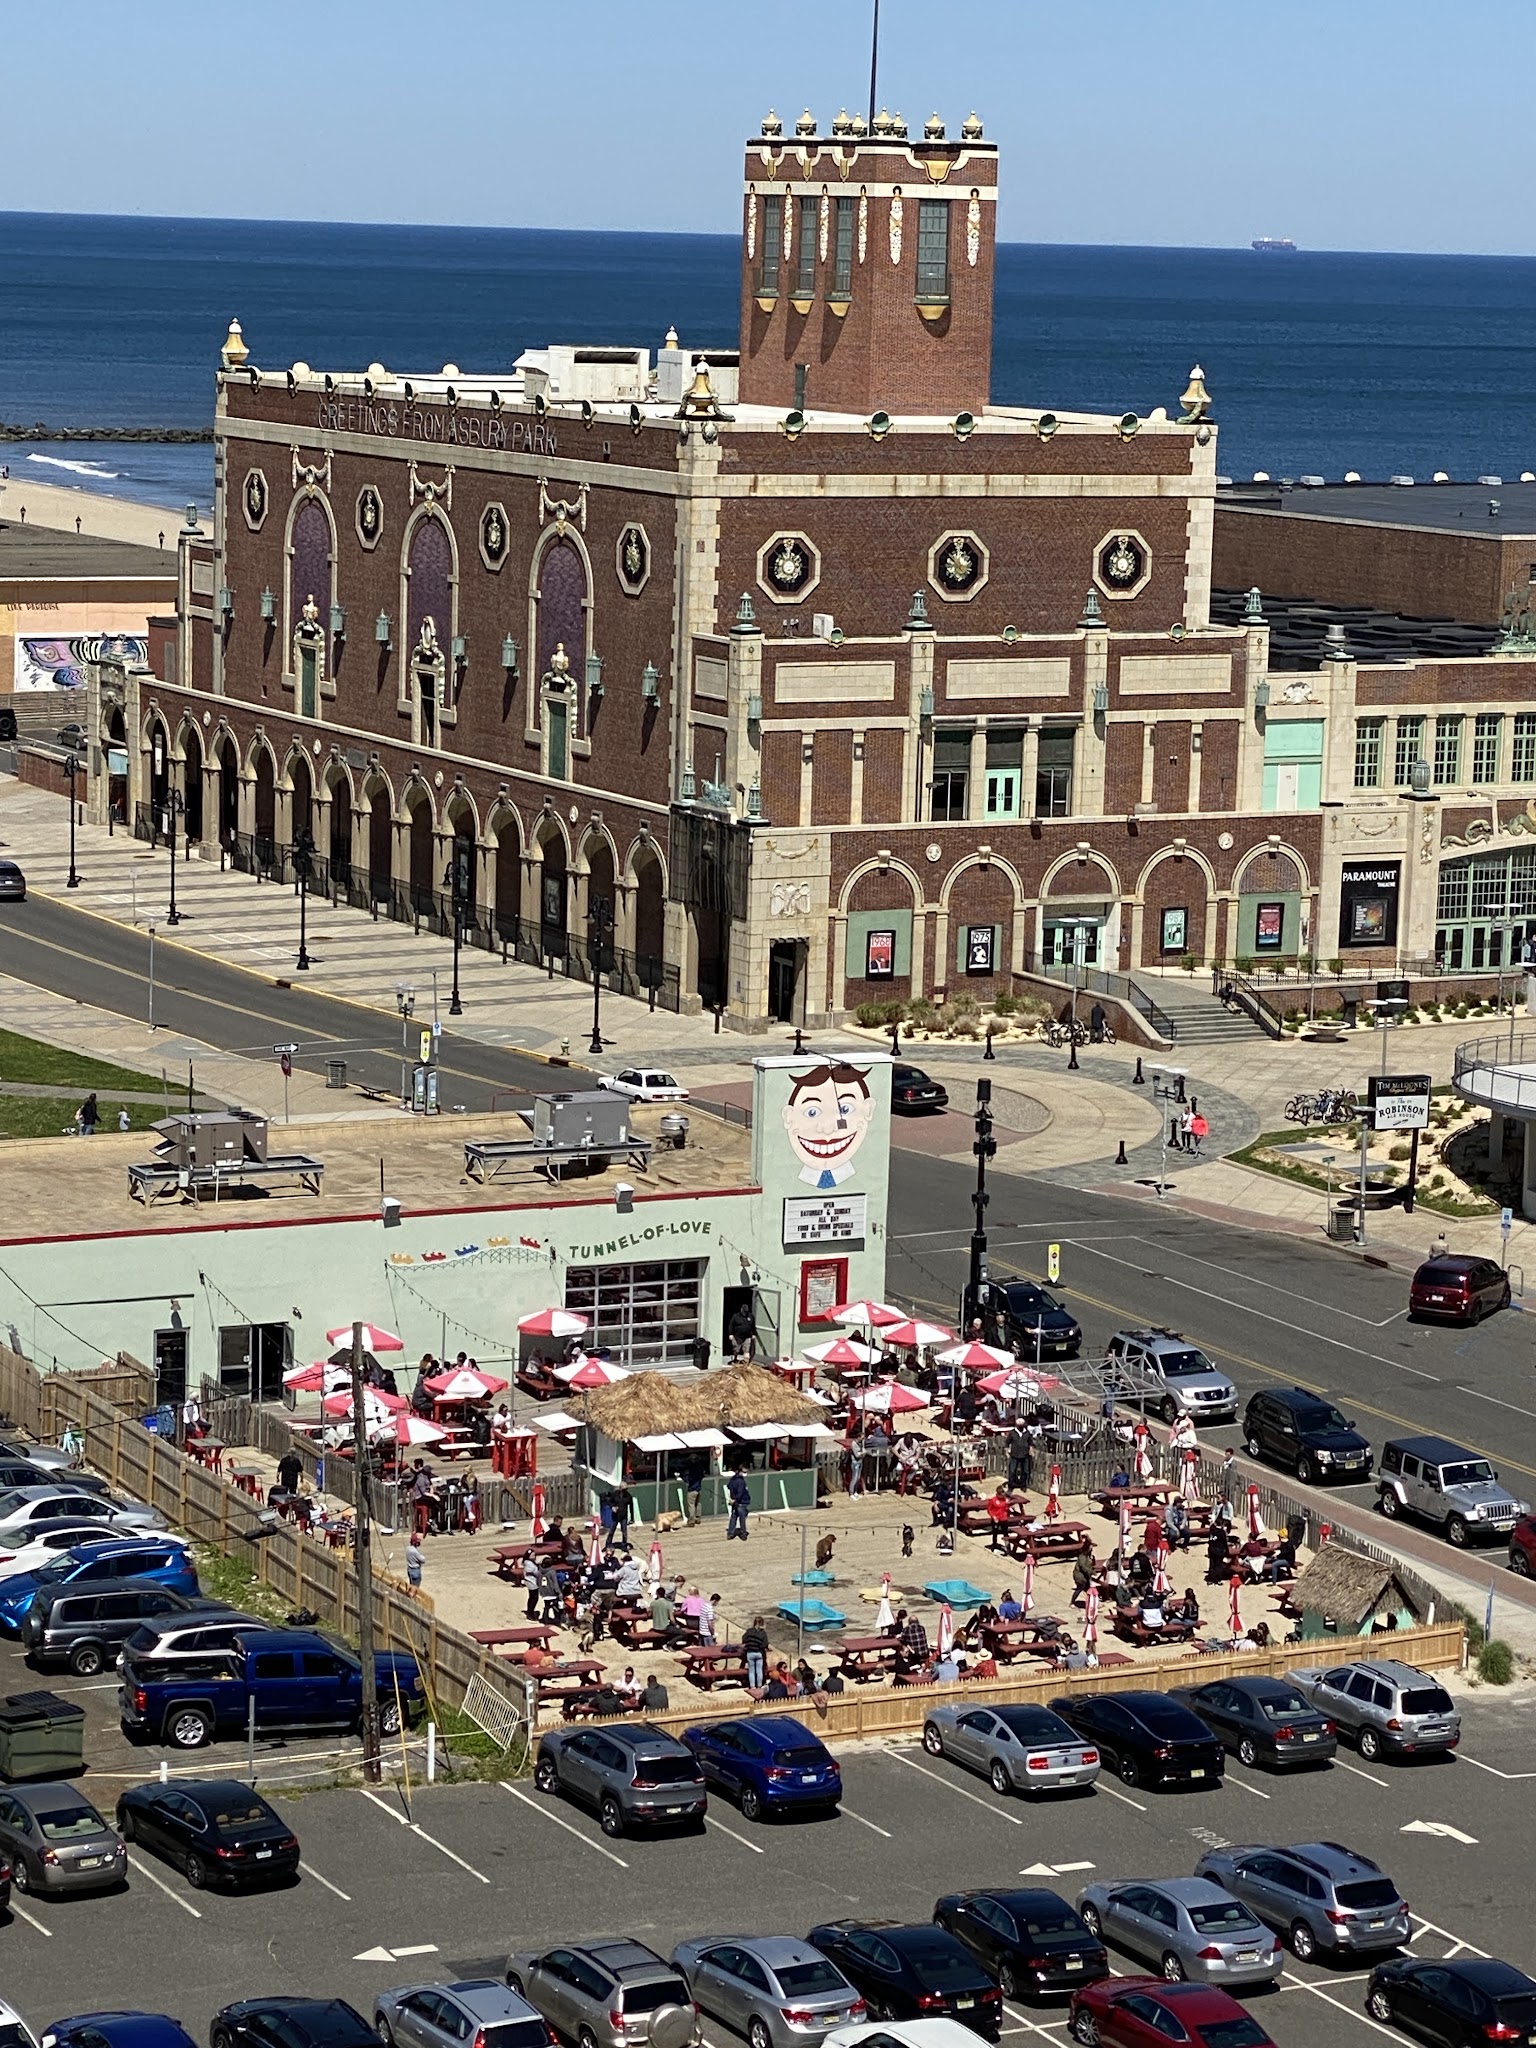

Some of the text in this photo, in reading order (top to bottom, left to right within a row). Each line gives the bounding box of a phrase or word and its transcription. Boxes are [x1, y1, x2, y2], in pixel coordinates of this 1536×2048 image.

[318, 402, 558, 455] GREETINGS FROM ASBURY PARK
[1342, 870, 1397, 882] PARAMOUNT
[871, 936, 891, 947] 1968
[971, 932, 990, 943] 1975
[1379, 1105, 1424, 1117] ROBINSON
